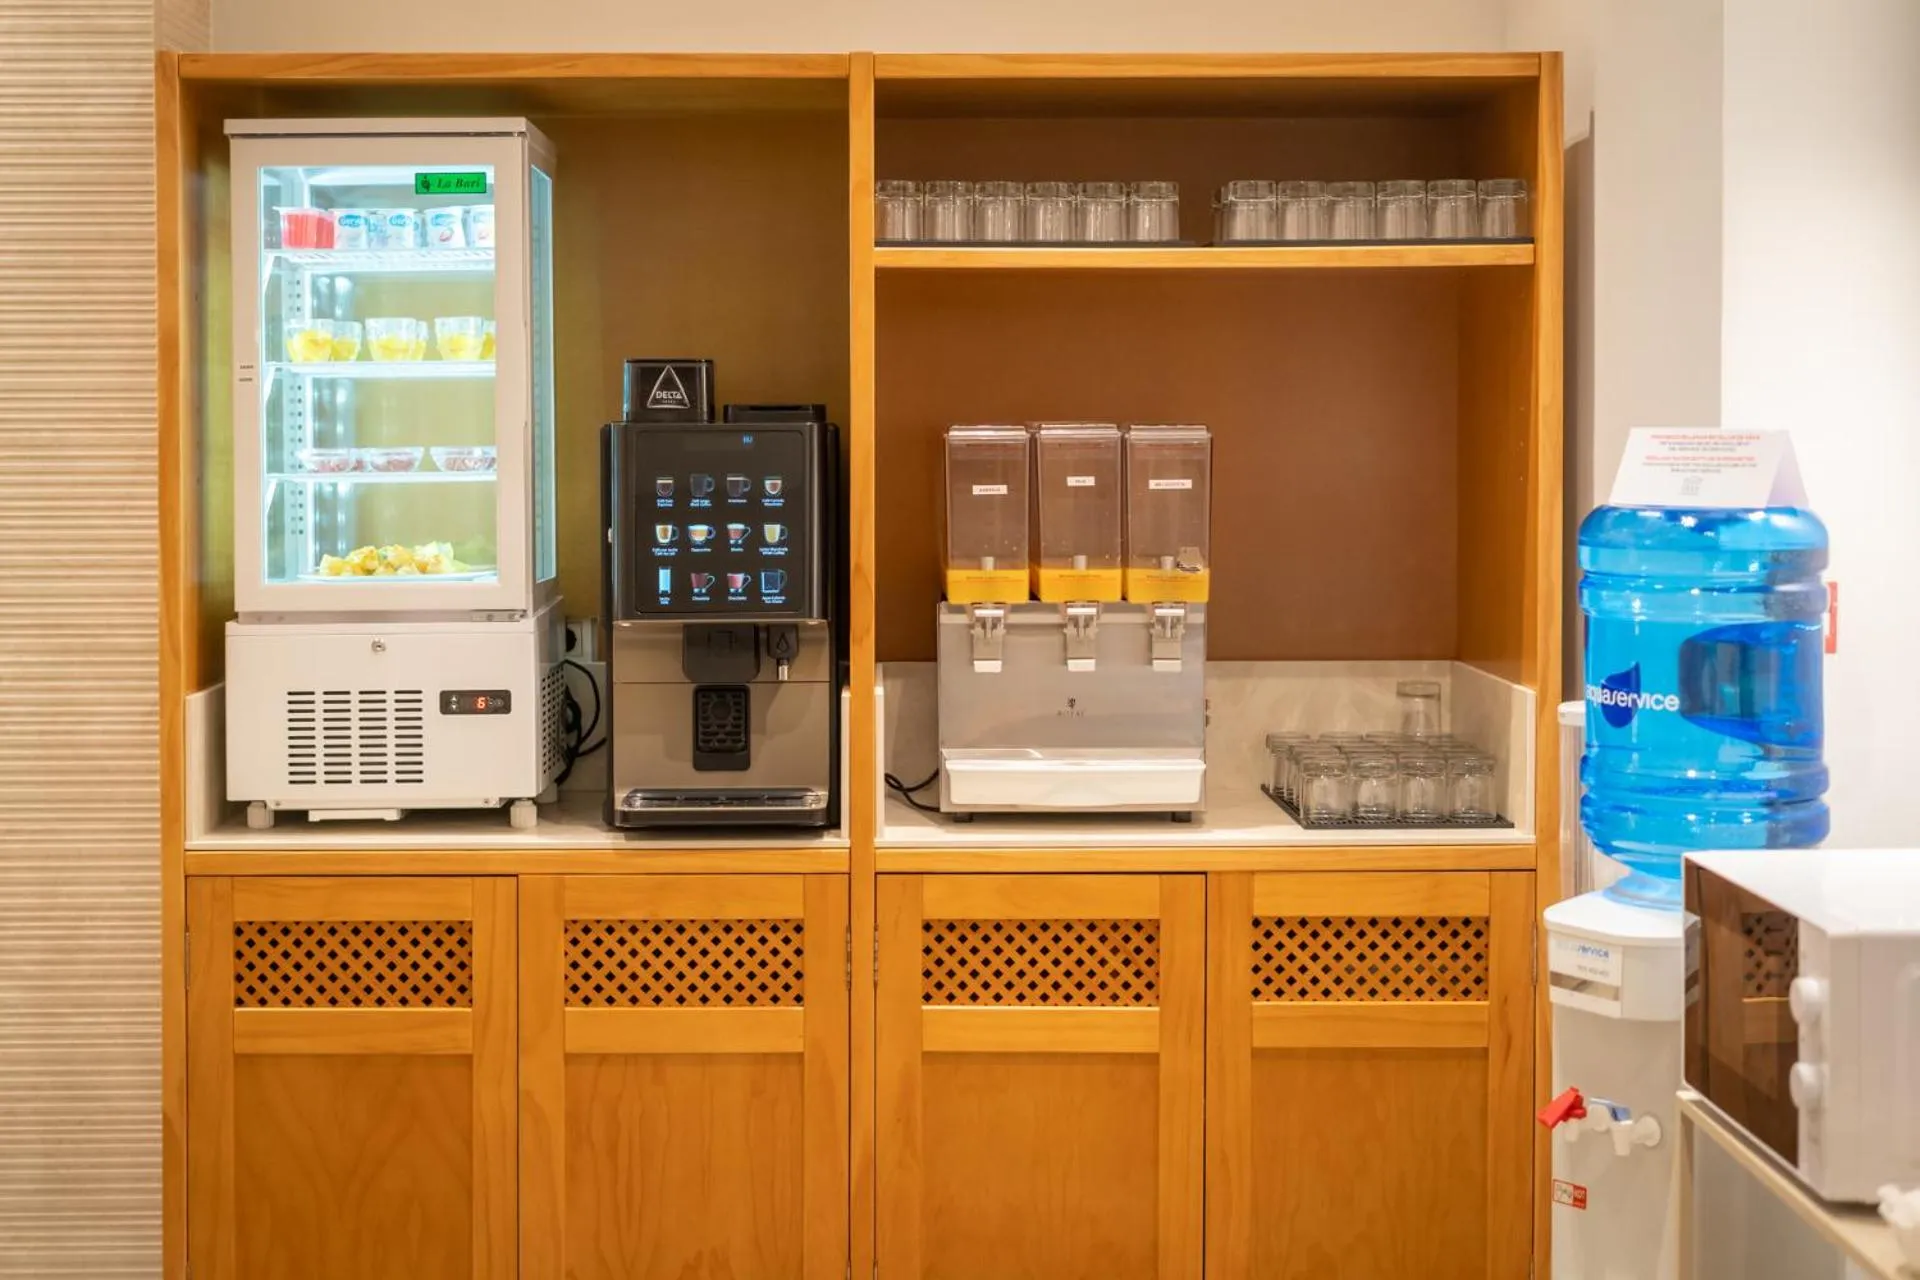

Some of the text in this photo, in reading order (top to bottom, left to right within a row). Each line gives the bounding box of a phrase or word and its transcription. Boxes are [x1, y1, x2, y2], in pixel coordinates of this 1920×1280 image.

[655, 390, 682, 399] DELTA
[476, 696, 486, 709] 6
[1585, 684, 1681, 711] aquaservice
